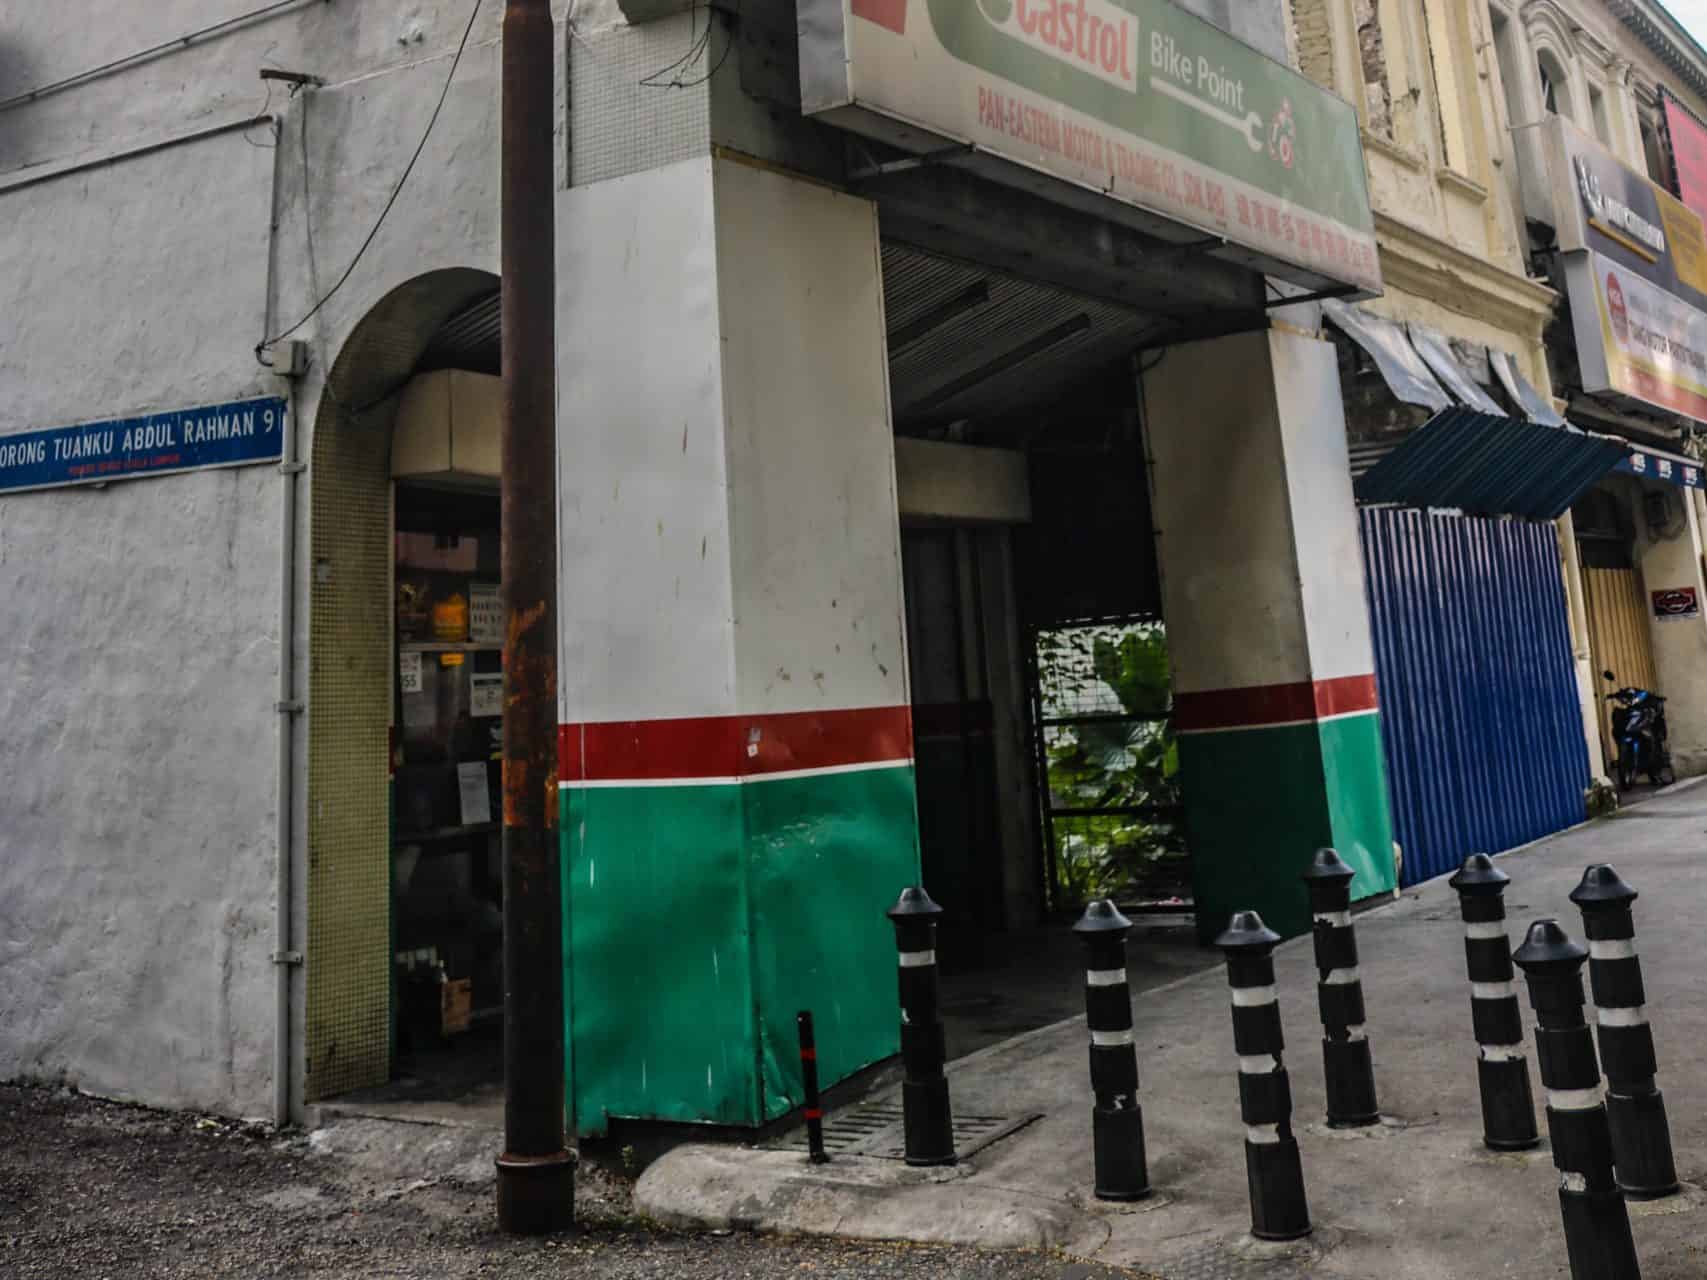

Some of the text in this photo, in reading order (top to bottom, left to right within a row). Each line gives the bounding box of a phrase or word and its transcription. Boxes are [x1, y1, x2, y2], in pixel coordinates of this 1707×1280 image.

[1151, 31, 1245, 112] Bike Point
[54, 432, 114, 459] TUANKU
[122, 423, 177, 452] ABDUL
[184, 411, 255, 444] RAHMAN
[263, 408, 274, 434] 9
